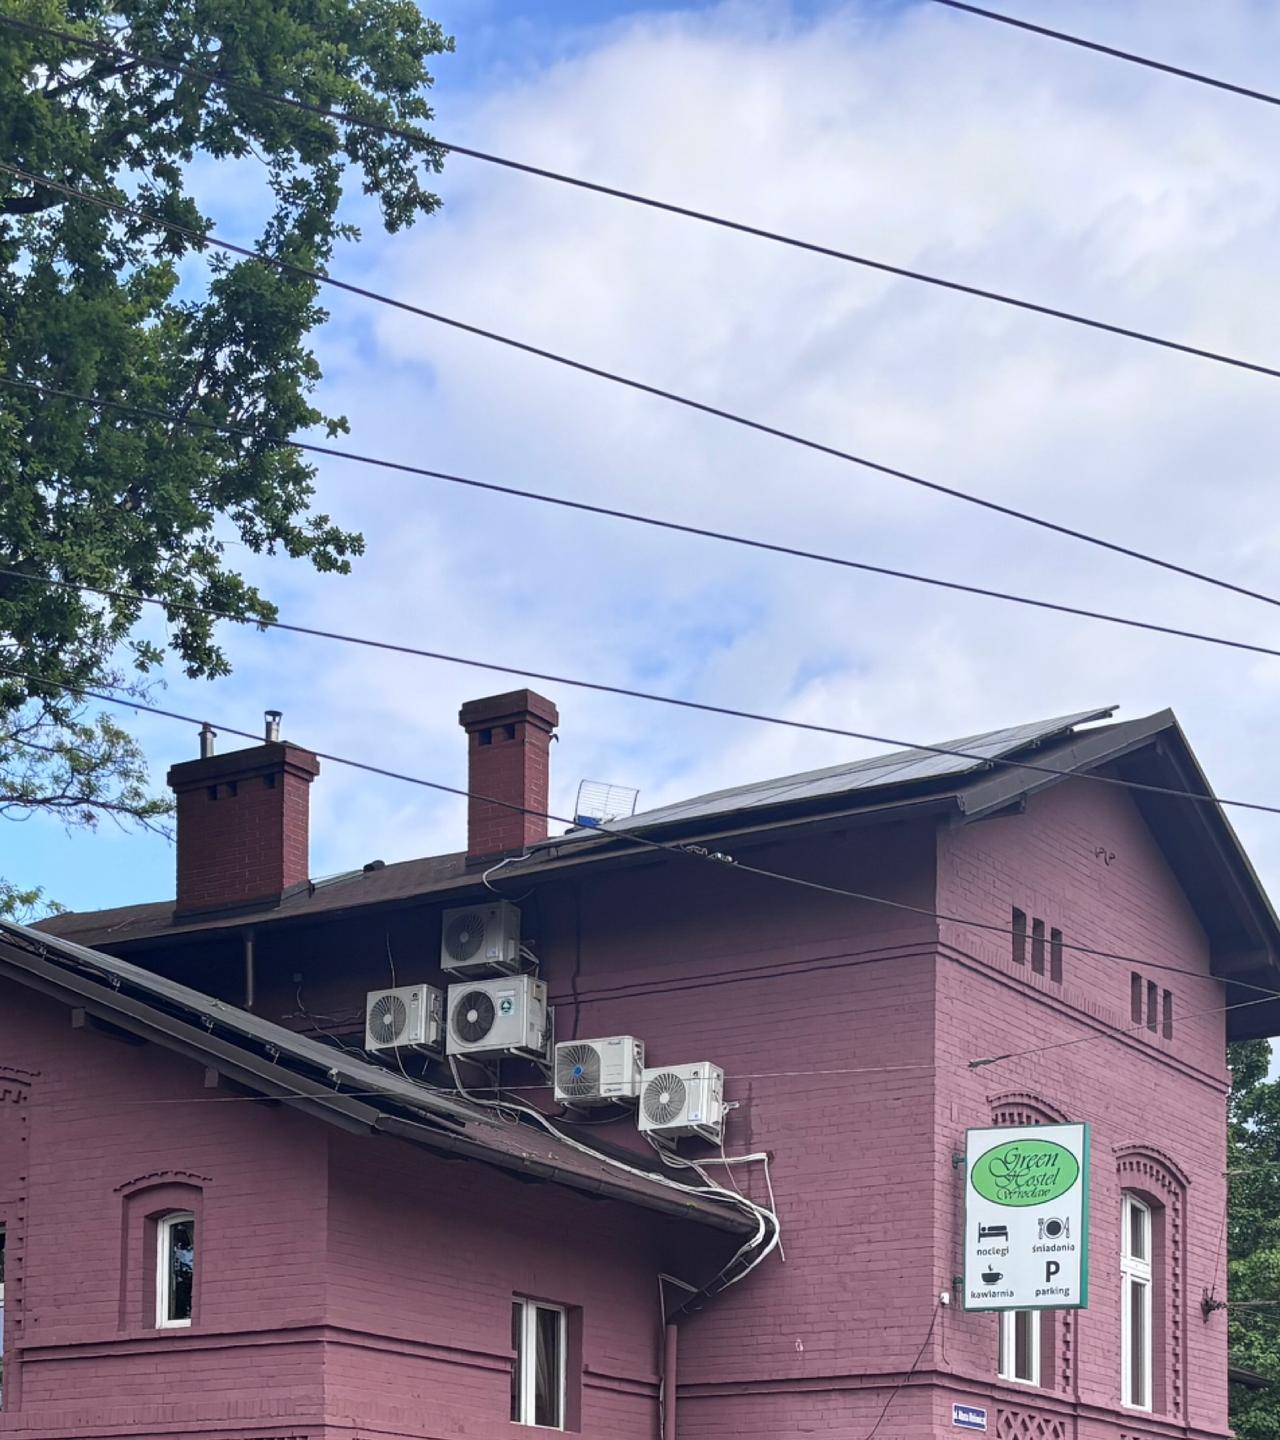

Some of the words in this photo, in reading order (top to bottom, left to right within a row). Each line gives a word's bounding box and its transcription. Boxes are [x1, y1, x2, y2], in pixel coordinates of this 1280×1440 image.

[988, 1147, 1060, 1177] Green
[995, 1168, 1061, 1188] Hostel
[976, 1246, 1010, 1257] noclegi
[1032, 1243, 1075, 1253] śniadania
[1045, 1260, 1061, 1283] P
[970, 1289, 1015, 1299] kawiarnia
[1035, 1286, 1070, 1298] parking
